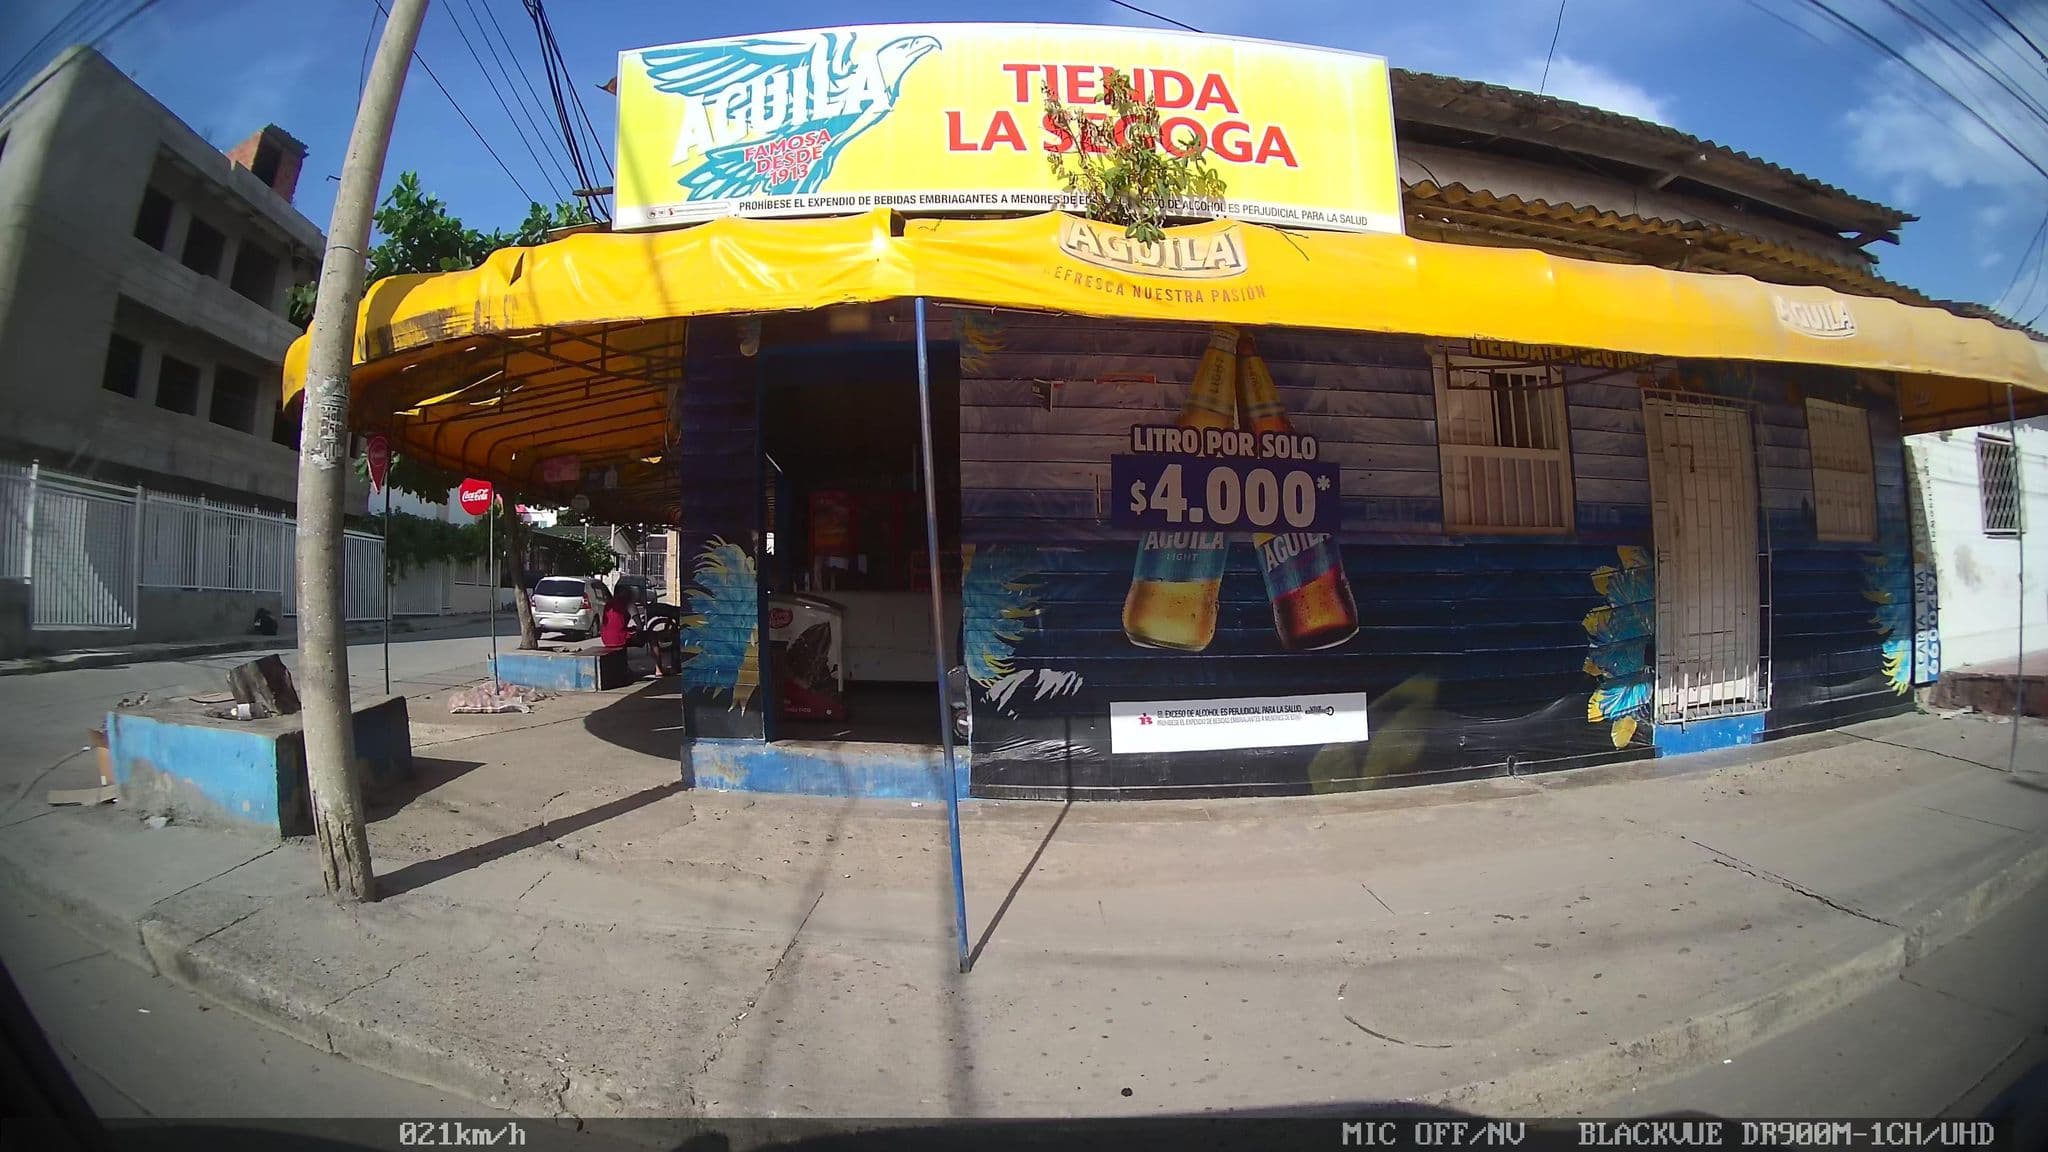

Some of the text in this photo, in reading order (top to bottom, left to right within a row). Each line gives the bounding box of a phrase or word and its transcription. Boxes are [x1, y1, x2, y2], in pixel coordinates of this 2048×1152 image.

[1003, 63, 1240, 114] TIENDA
[745, 129, 831, 161] FAMOSA
[945, 110, 1027, 152] LA
[757, 145, 822, 173] DESDE
[771, 163, 808, 185] 1913
[794, 198, 806, 208] EL
[808, 196, 855, 207] EXPENDIO
[858, 196, 871, 206] DE
[874, 195, 916, 206] BEBIDAS
[919, 194, 998, 205] EMBRIAGANTES
[1000, 194, 1008, 204] A
[1011, 194, 1060, 205] MENORES
[1063, 194, 1076, 205] DE
[1167, 199, 1180, 209] DE
[1182, 200, 1226, 212] ALCOHOL
[1228, 203, 1241, 214] ES
[1242, 206, 1300, 219] PERJUDICIAL
[1301, 210, 1325, 221] PARA
[1327, 213, 1338, 222] LA
[1339, 214, 1368, 226] SALUD
[1066, 220, 1241, 272] AGUILA
[1132, 285, 1204, 303] NUESTRA
[1134, 426, 1316, 460] LITRO POR SOLO
